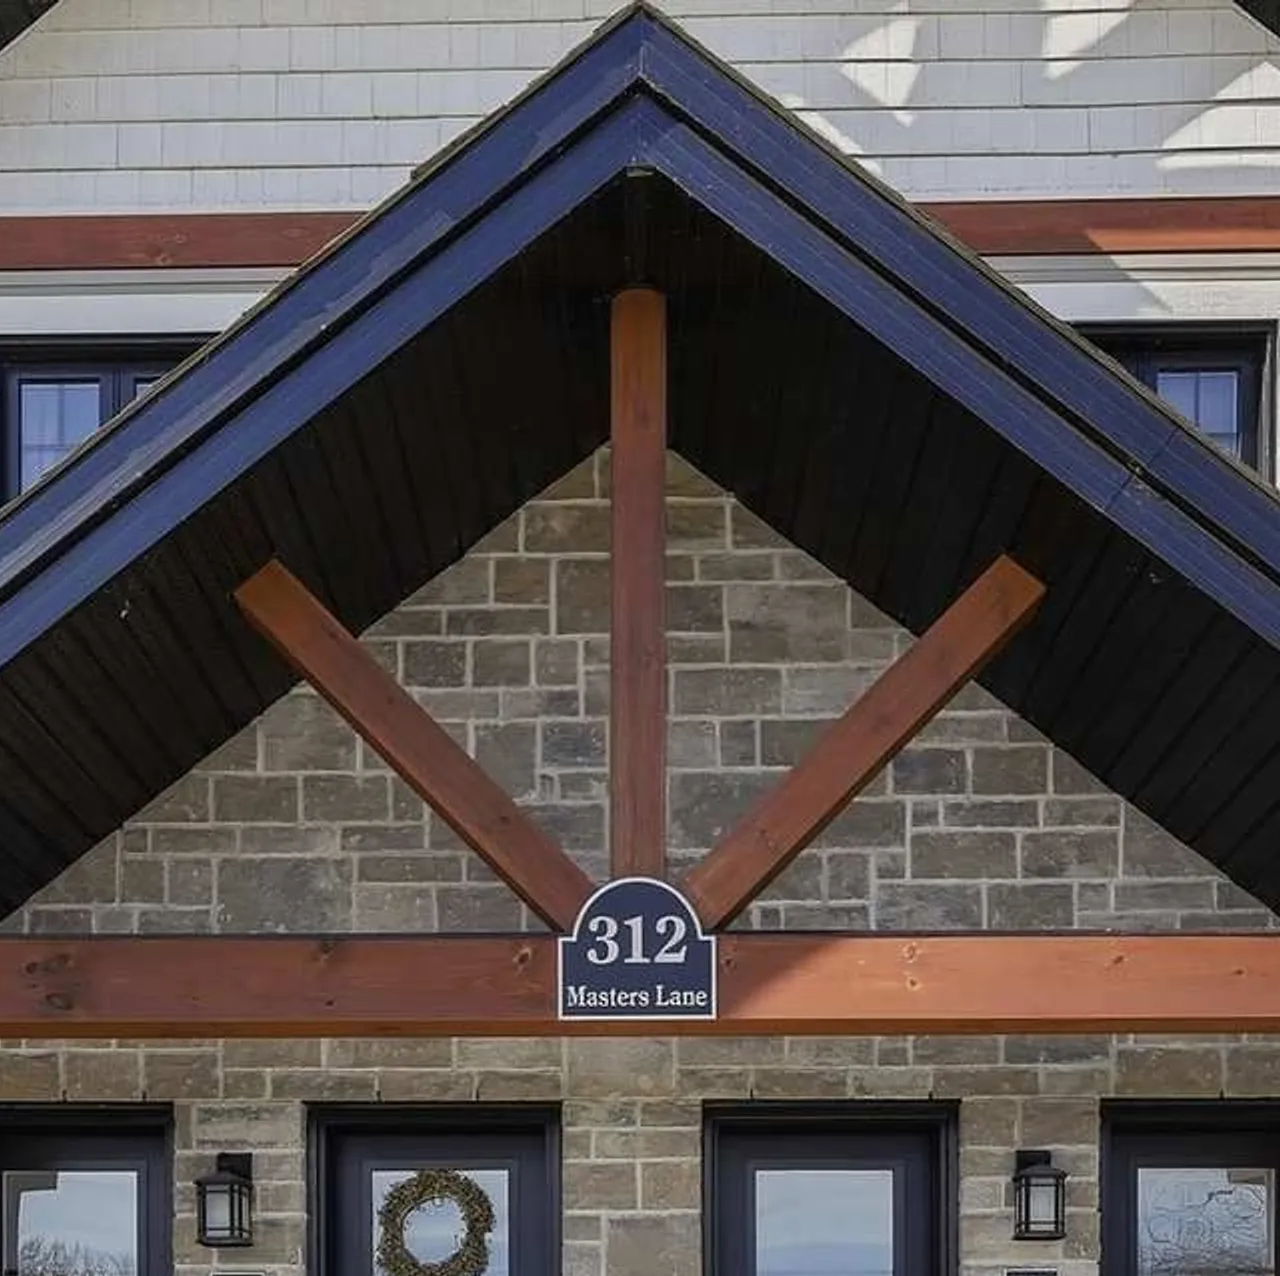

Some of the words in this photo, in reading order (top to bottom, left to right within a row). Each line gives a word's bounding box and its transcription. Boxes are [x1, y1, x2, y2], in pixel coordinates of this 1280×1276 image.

[586, 915, 688, 965] 312
[567, 985, 650, 1008] Masters
[654, 984, 708, 1007] Lane
